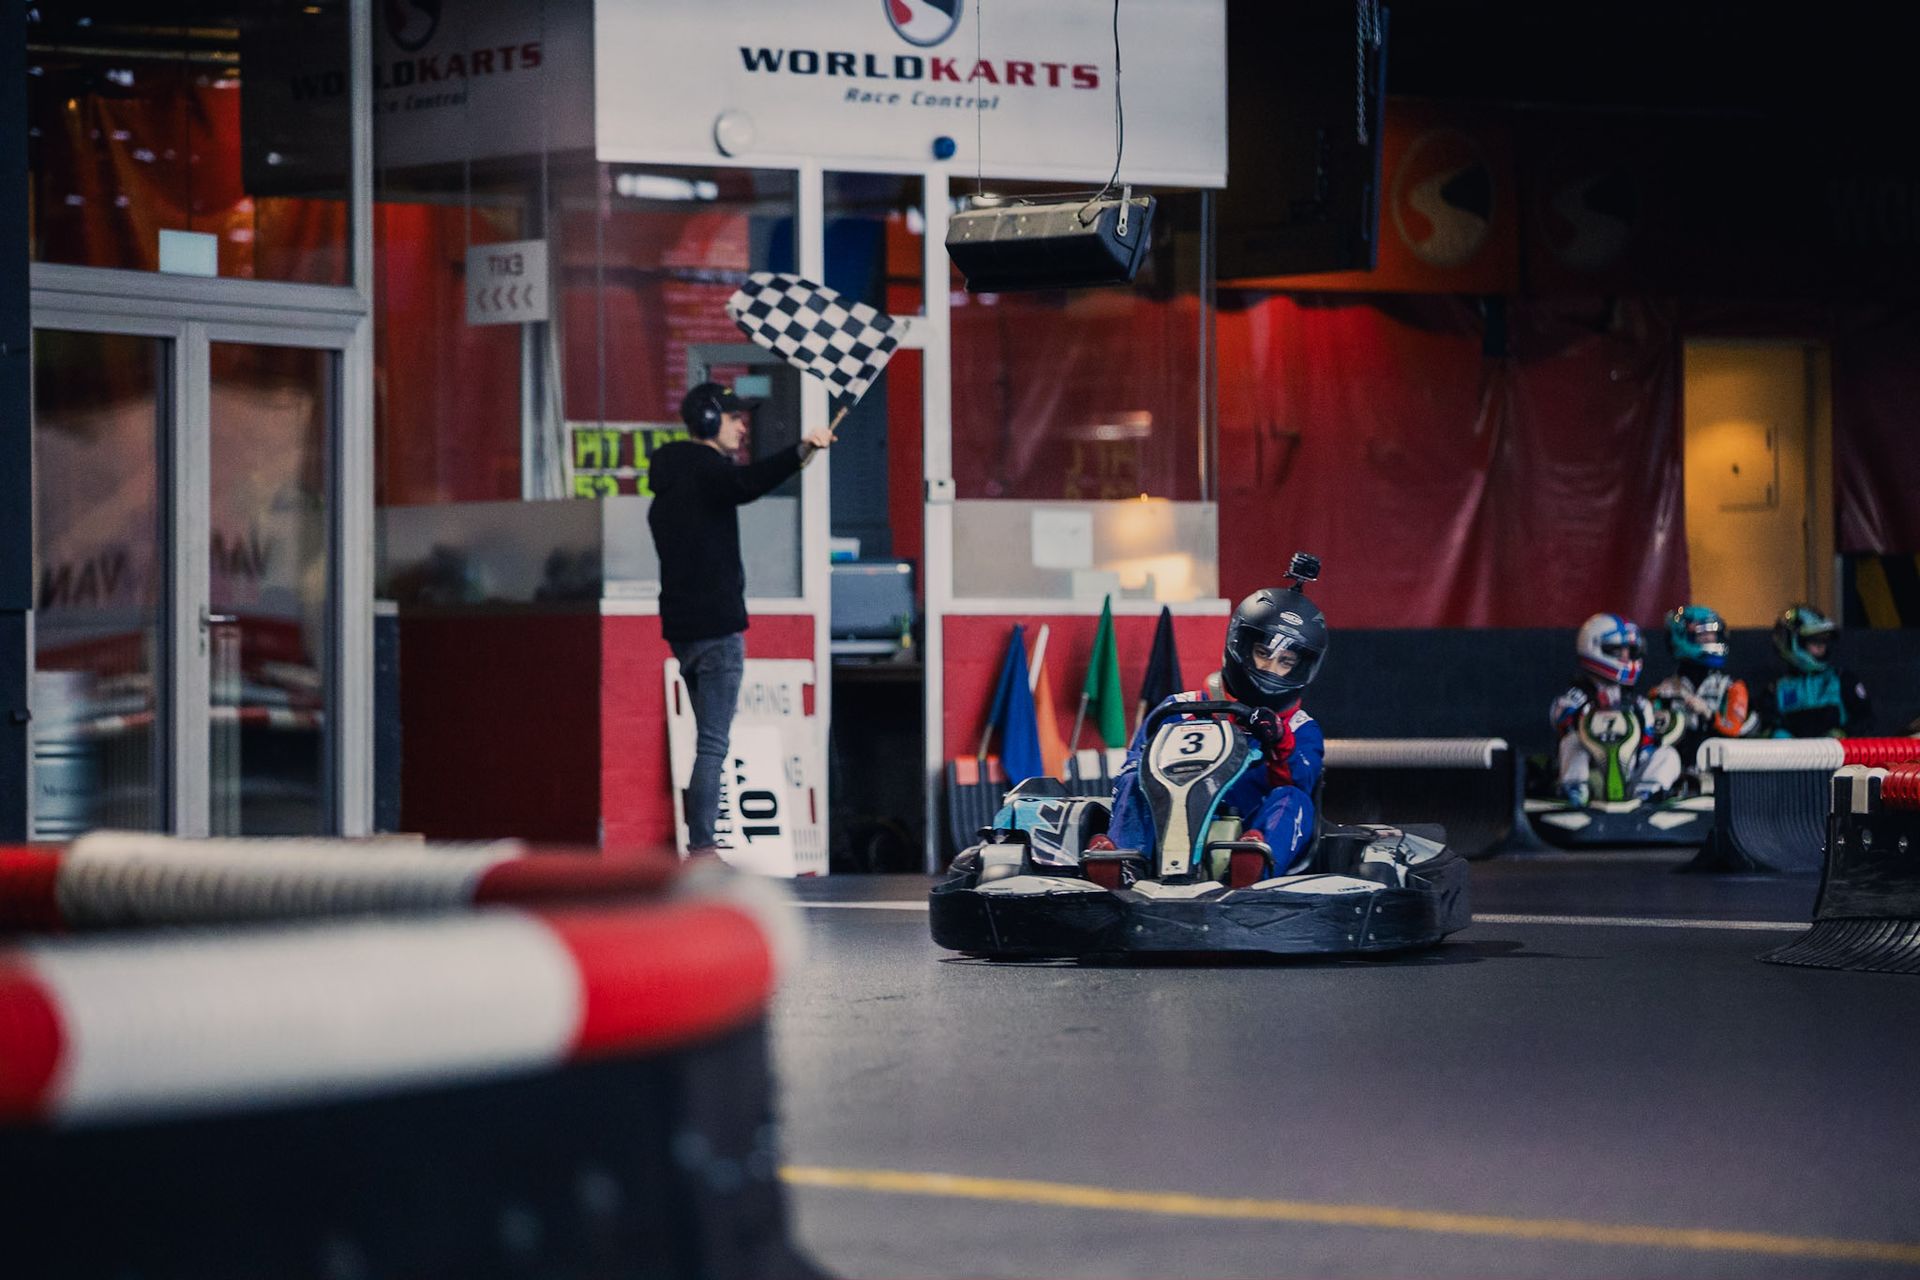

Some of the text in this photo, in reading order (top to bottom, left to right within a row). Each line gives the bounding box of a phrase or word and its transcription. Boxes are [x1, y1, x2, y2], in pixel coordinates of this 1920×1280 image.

[290, 43, 543, 100] WOLDKARTS
[739, 46, 1100, 90] WORLDKARTS
[845, 87, 1001, 109] Race Control
[1180, 732, 1205, 754] 3
